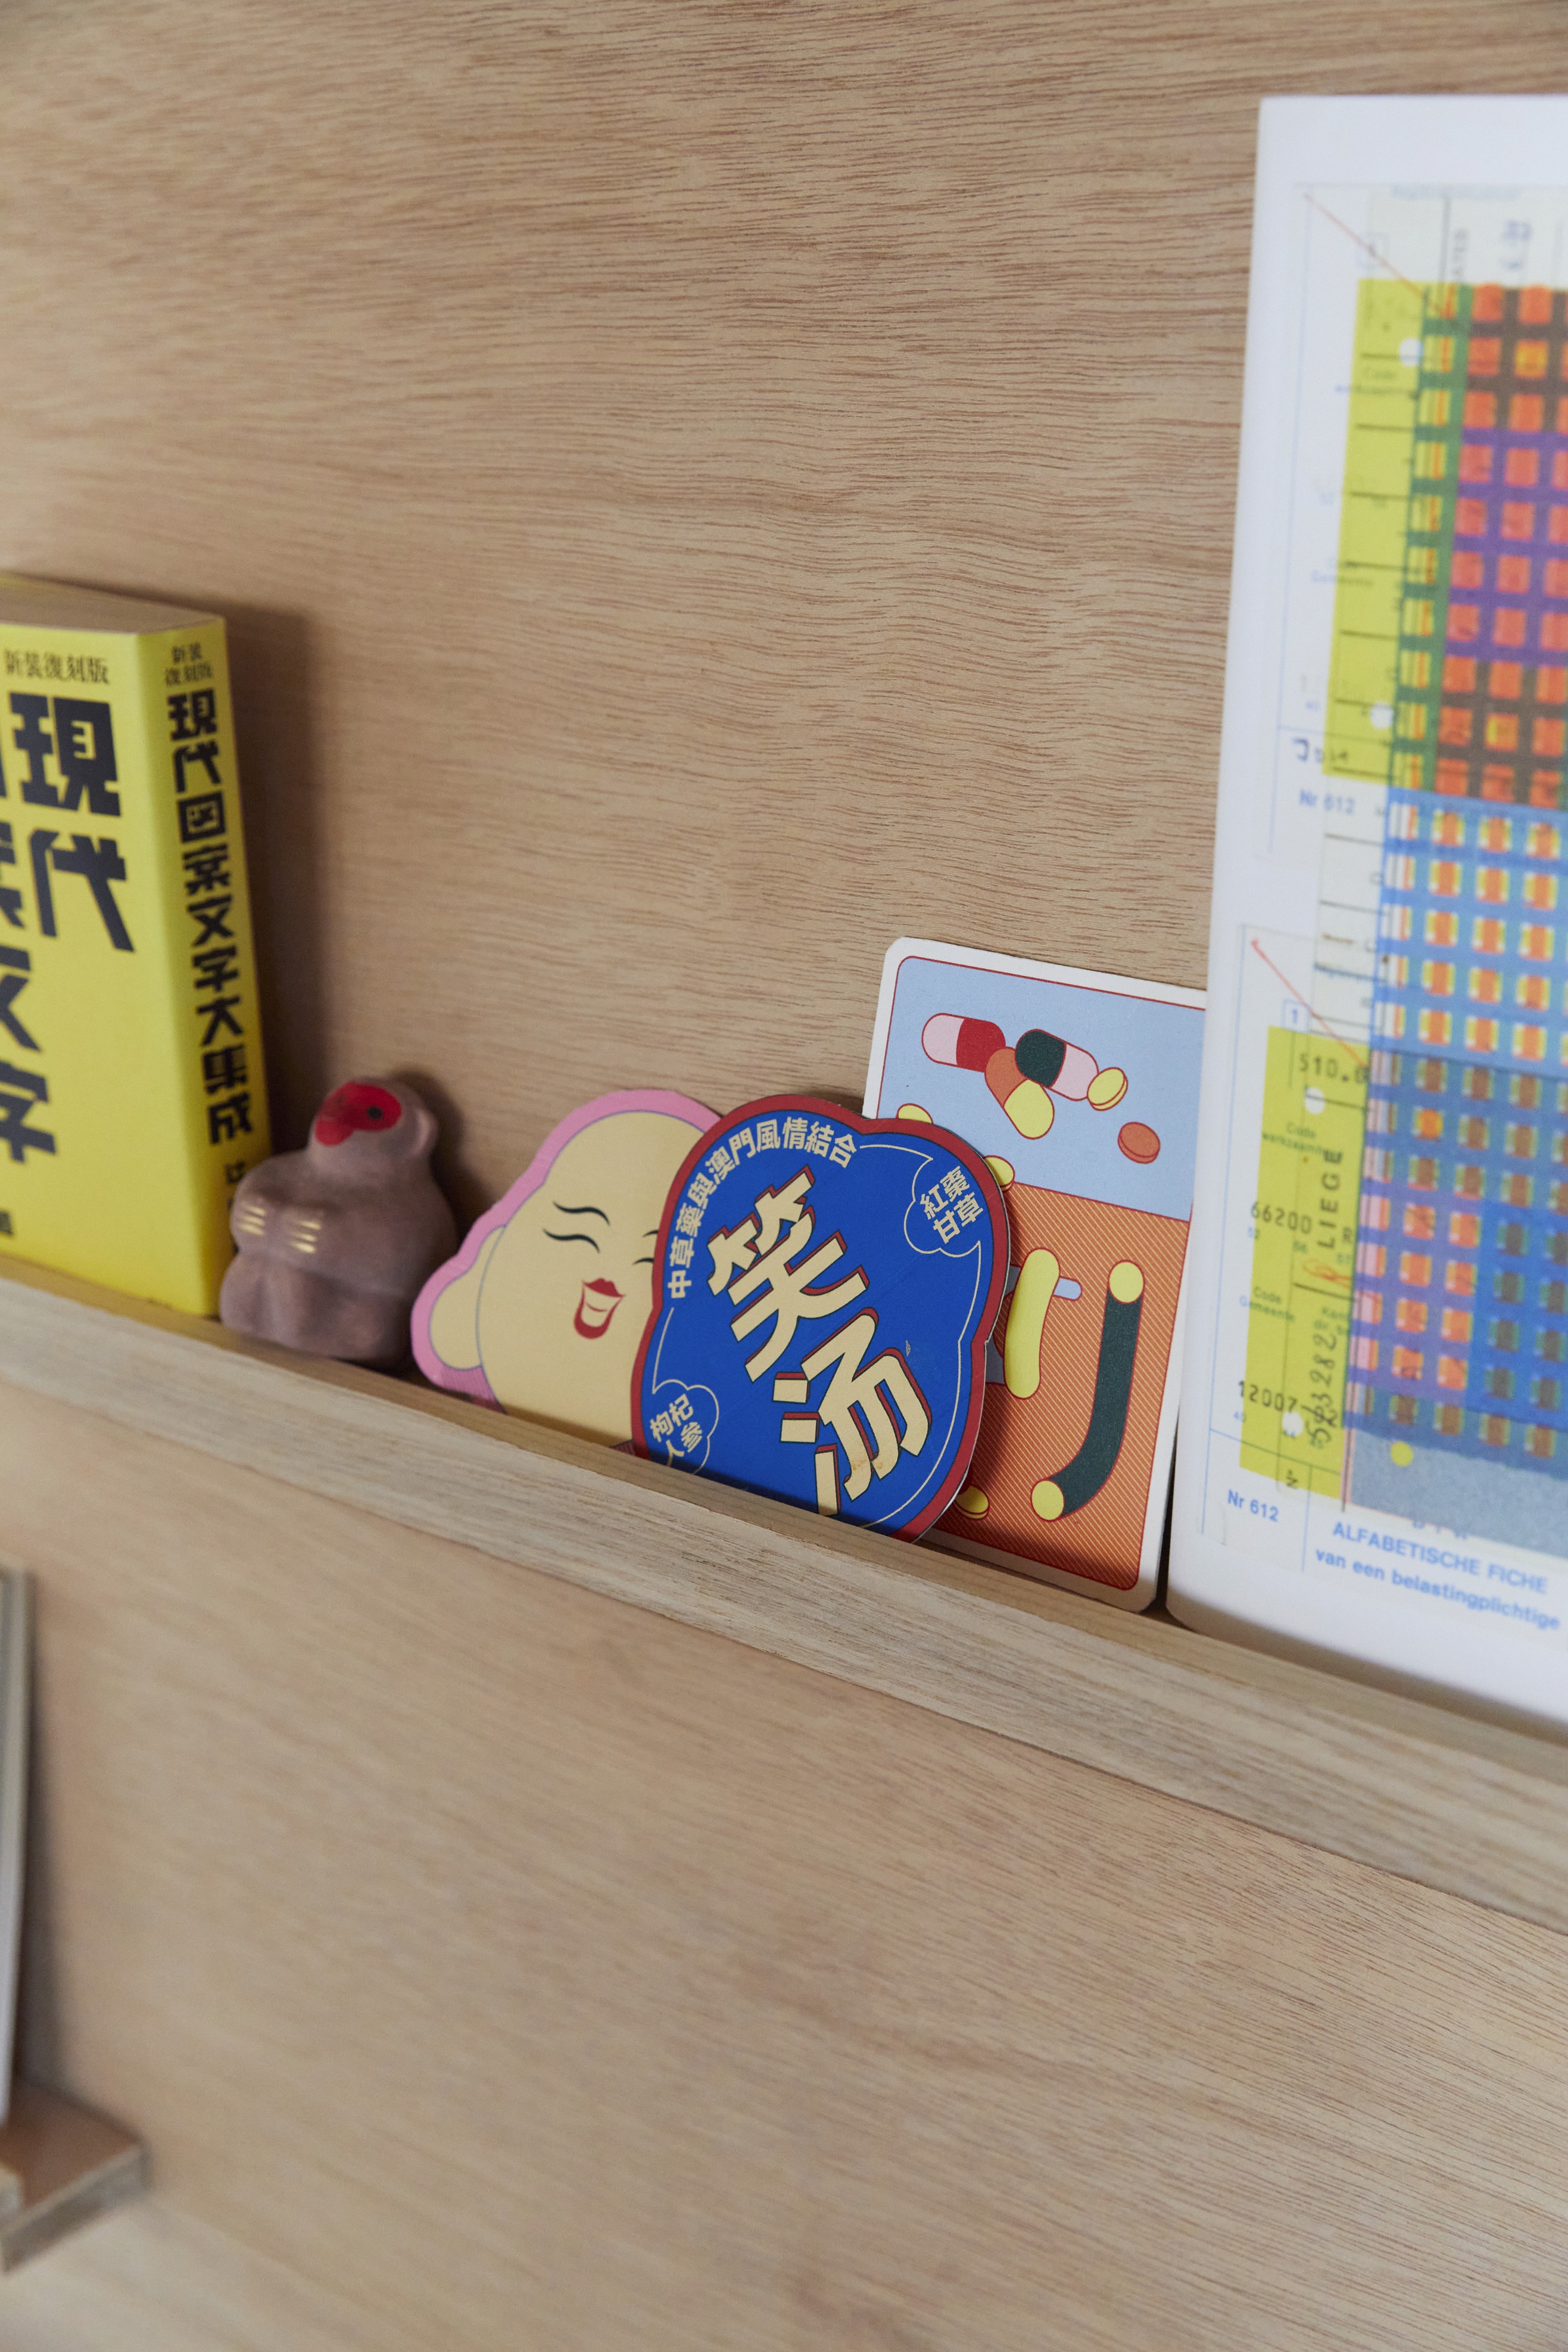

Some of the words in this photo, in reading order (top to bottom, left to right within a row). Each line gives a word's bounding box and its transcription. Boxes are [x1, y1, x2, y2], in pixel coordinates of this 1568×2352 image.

[10, 691, 135, 952] 現代
[668, 1117, 858, 1299] 中草藥與澳門風情結合
[920, 1166, 970, 1220] 紅棗
[933, 1192, 984, 1244] 甘草
[1252, 1201, 1311, 1234] 66200
[1317, 1149, 1343, 1250] LIEGE
[650, 1394, 694, 1443] 枸杞
[1228, 1489, 1244, 1509] Nr
[1249, 1499, 1279, 1523] 612
[1316, 1549, 1346, 1569] van
[1352, 1560, 1385, 1581] een
[1392, 1569, 1561, 1630] belastingplichtige
[1332, 1521, 1482, 1576] ALFABETISCHE
[1488, 1563, 1550, 1595] FICHE
